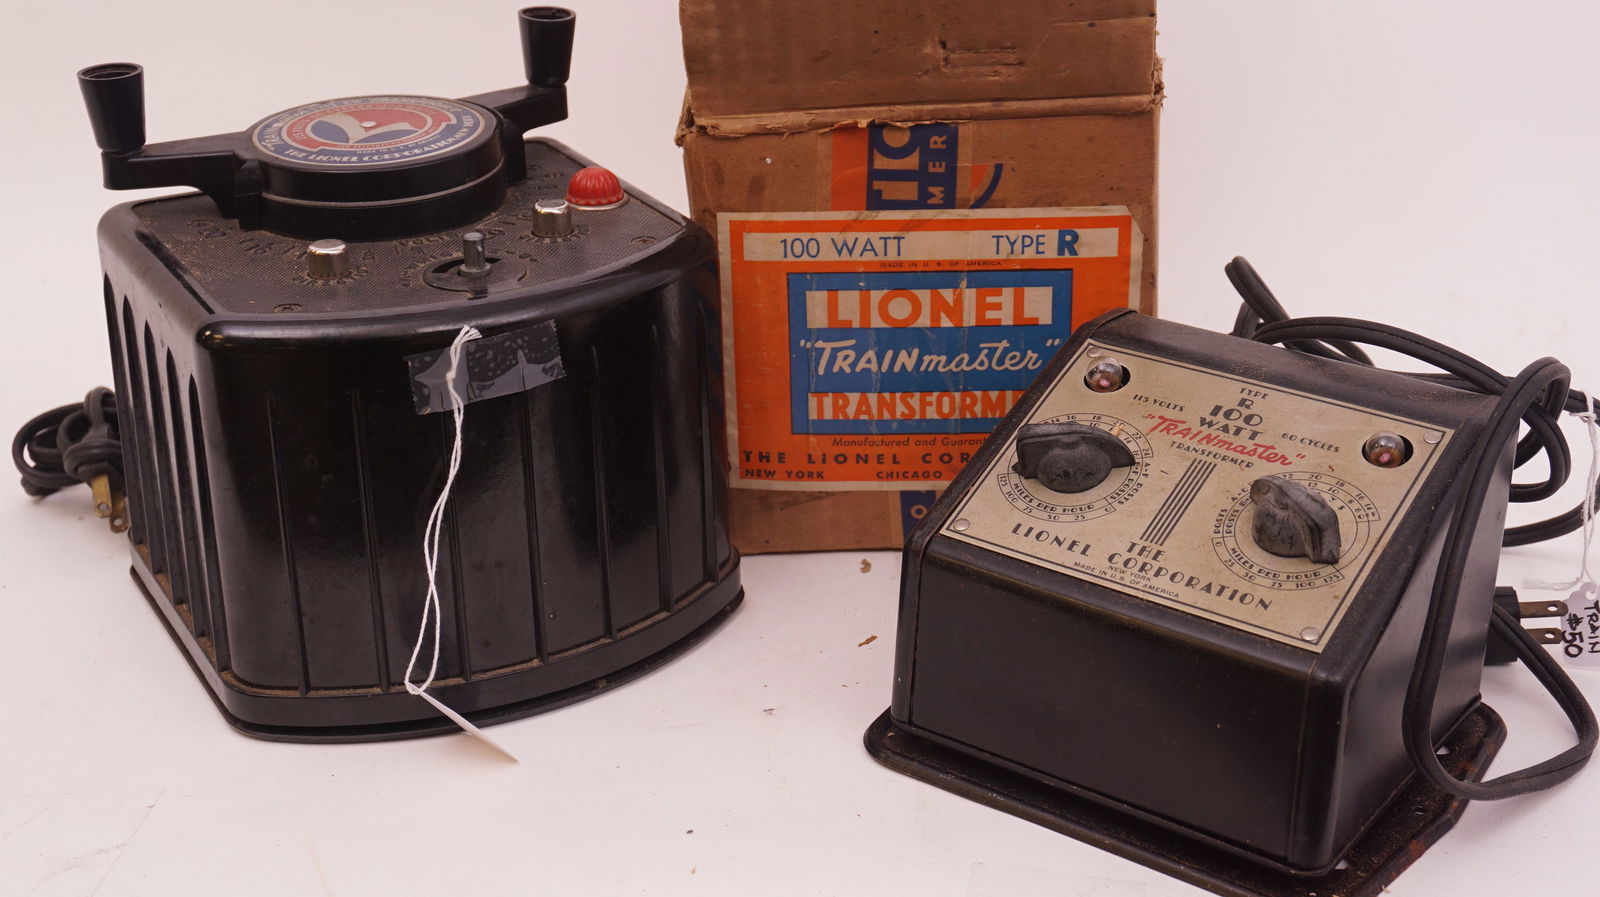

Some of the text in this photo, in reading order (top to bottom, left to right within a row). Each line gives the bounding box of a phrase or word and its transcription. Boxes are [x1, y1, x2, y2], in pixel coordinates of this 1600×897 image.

[284, 149, 305, 158] THE
[308, 153, 358, 162] LIONEL
[780, 229, 1080, 259] 100 WATT TYPE R
[827, 287, 1040, 329] LIONEL
[1132, 394, 1185, 412] 115 VOLTS
[1236, 398, 1255, 410] R
[1239, 387, 1270, 400] TYPE
[1209, 404, 1264, 427] 100
[1131, 432, 1142, 440] 22
[1199, 417, 1264, 441] WATT
[832, 437, 911, 448] Manufactured
[914, 437, 936, 447] and
[1281, 432, 1341, 453] 60 CYCLES
[743, 450, 787, 465] THE
[807, 452, 901, 465] LIONEL
[1170, 440, 1255, 469] TRANSFORMER
[744, 469, 944, 480] NEW YORK CHICAGO
[999, 475, 1008, 487] 125
[1005, 491, 1019, 503] 100
[1023, 506, 1033, 514] 75
[1012, 483, 1094, 513] MILES PER HOUR
[1110, 478, 1135, 501] POSTS
[1118, 483, 1143, 505] POSTS
[1213, 508, 1227, 534] POSTS
[1225, 508, 1240, 534] POSTS
[1011, 523, 1092, 557] LIONEL
[1127, 541, 1166, 563] THE
[1230, 547, 1321, 580] MILES PER HOUR
[1073, 561, 1096, 573] MADE
[1142, 583, 1180, 598] AMERICA
[1107, 552, 1273, 611] CORPORATION
[1108, 565, 1152, 583] NEW YORK
[1224, 558, 1235, 568] 25
[1243, 572, 1257, 581] 50
[1295, 580, 1316, 588] 100
[1323, 574, 1340, 584] 125
[1562, 613, 1584, 658] $50
